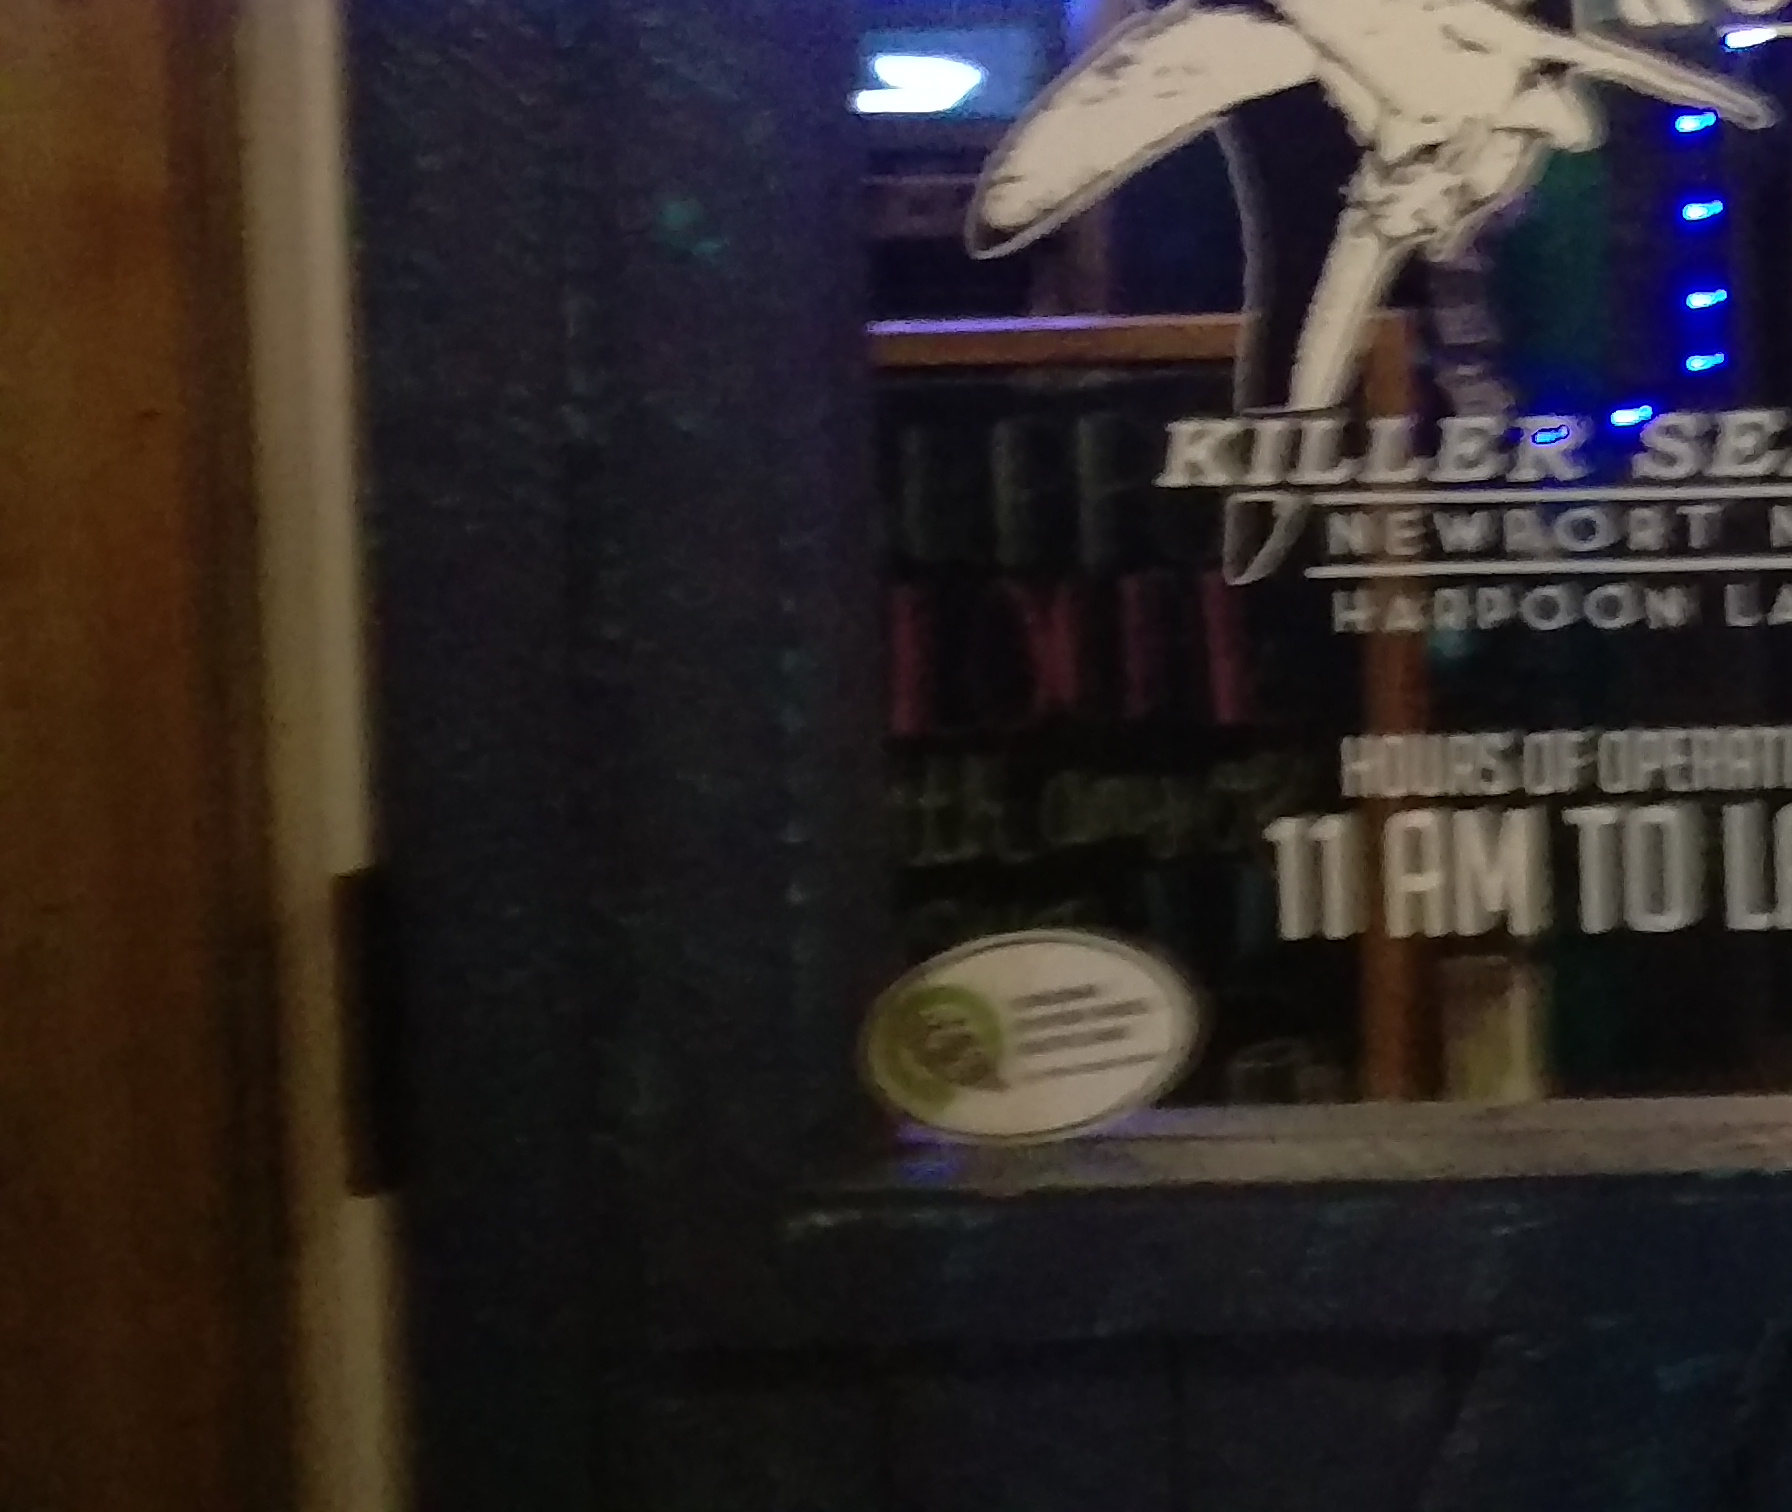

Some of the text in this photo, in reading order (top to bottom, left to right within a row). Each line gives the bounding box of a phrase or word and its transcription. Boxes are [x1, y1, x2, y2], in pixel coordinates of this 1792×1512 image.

[1152, 414, 1595, 488] KILLER
[1325, 502, 1726, 556] NEWPORT
[1331, 582, 1697, 635] HARPOON
[1341, 728, 1517, 799] HOURS
[1522, 728, 1594, 797] OF
[1262, 810, 1370, 941] 11
[1383, 803, 1555, 940] AM
[1561, 798, 1705, 936] TO
